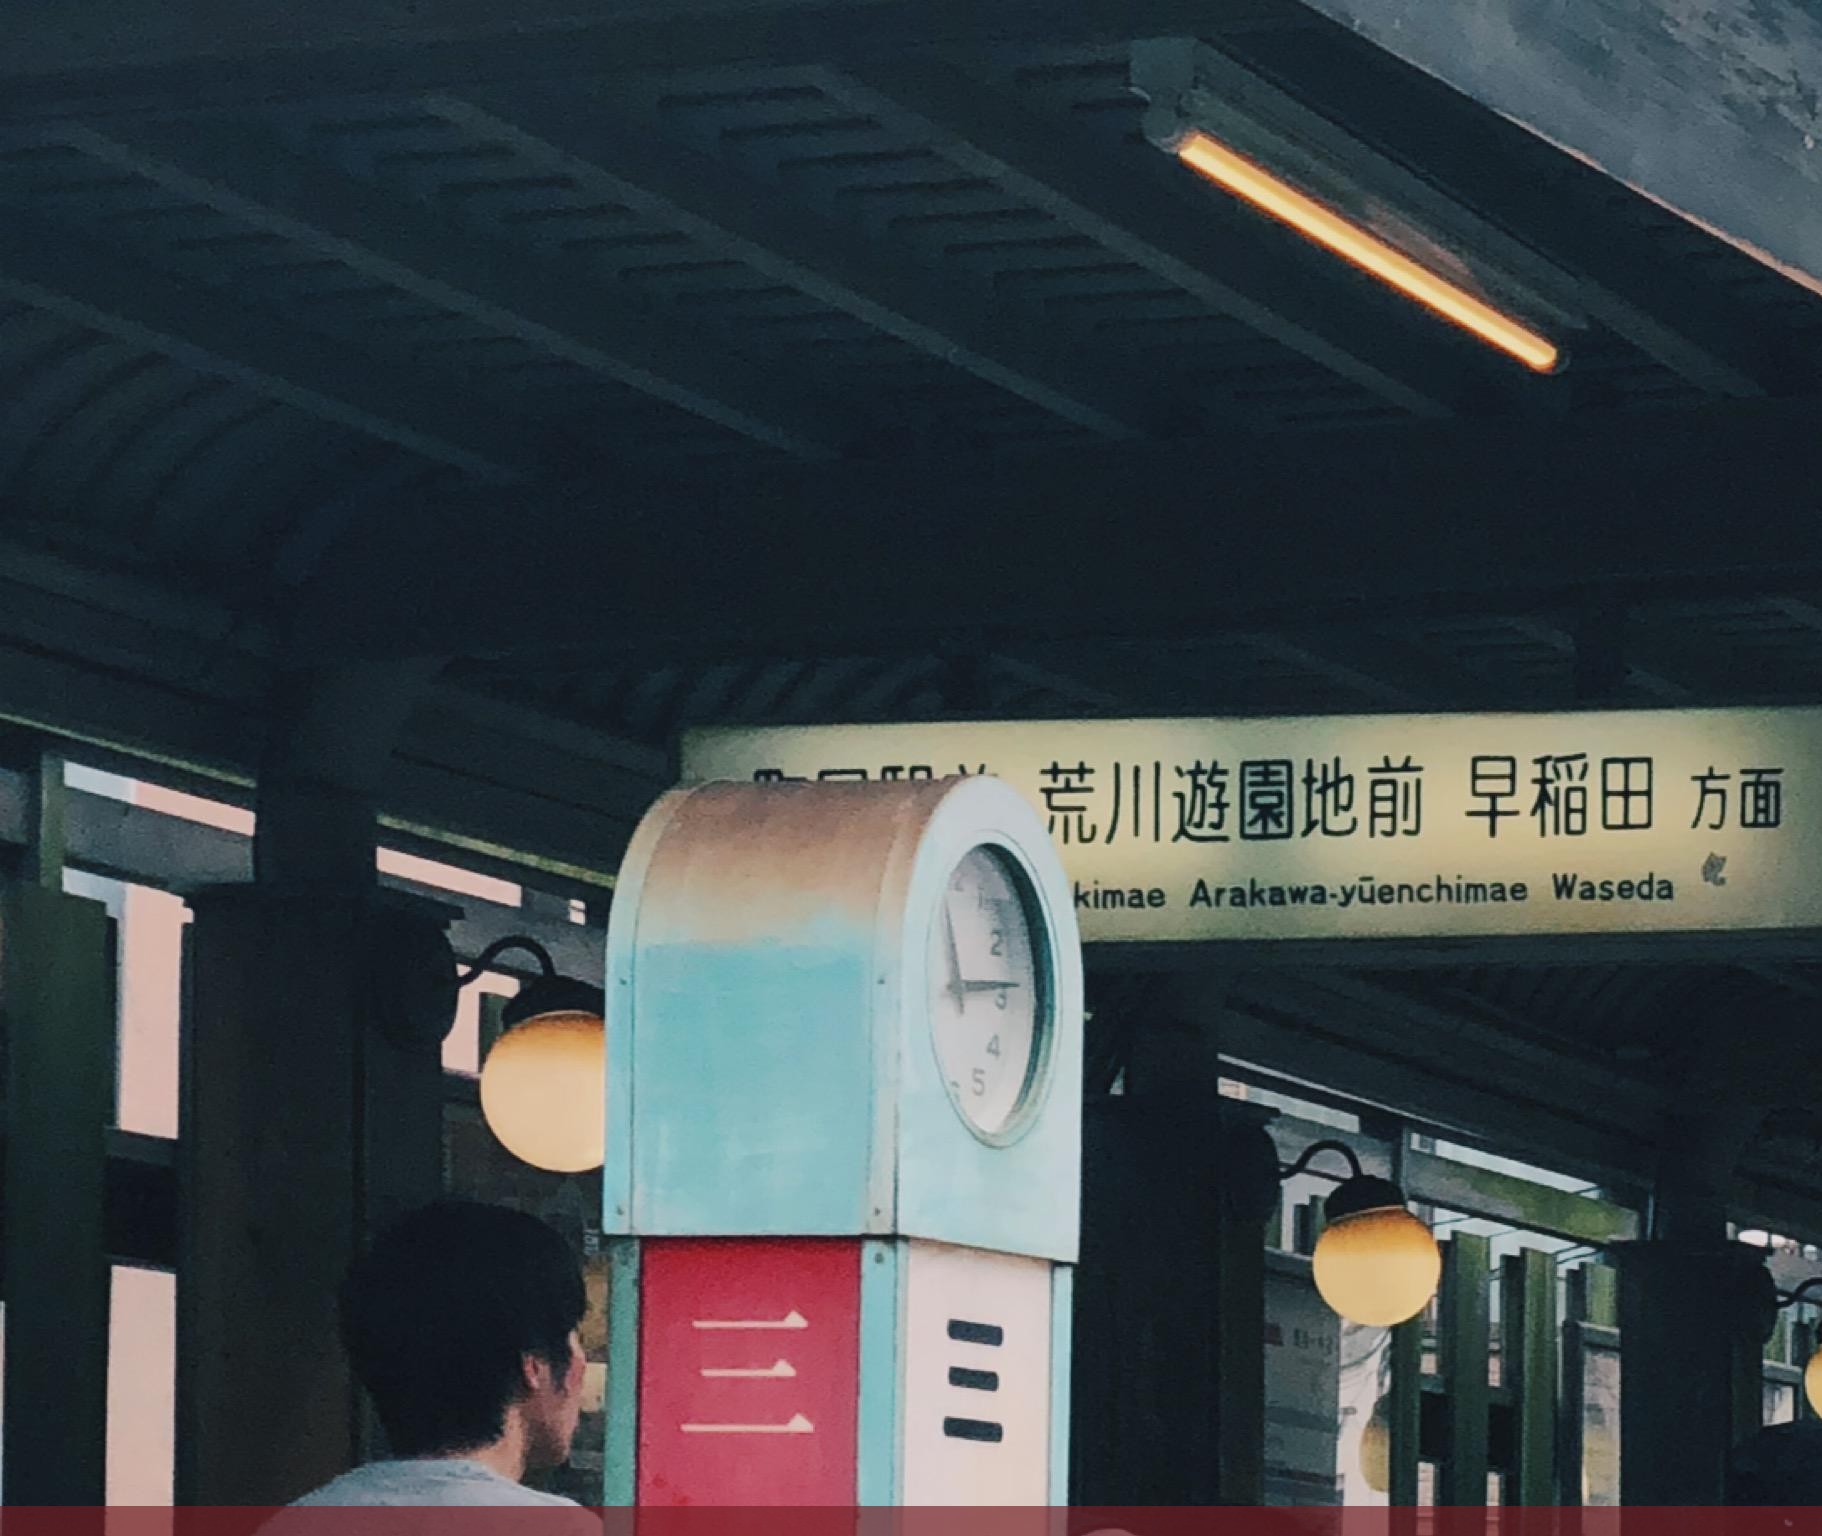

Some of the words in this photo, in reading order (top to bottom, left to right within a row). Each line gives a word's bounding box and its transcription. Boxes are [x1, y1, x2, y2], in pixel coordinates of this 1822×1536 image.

[1040, 754, 1425, 845] 荒川遊園地前
[1464, 752, 1654, 838] 早稲田
[1690, 765, 1785, 831] 方面
[1072, 879, 1167, 910] kimae
[1189, 874, 1529, 909] Arakawa-yūenchimae
[1551, 872, 1675, 902] Waseda
